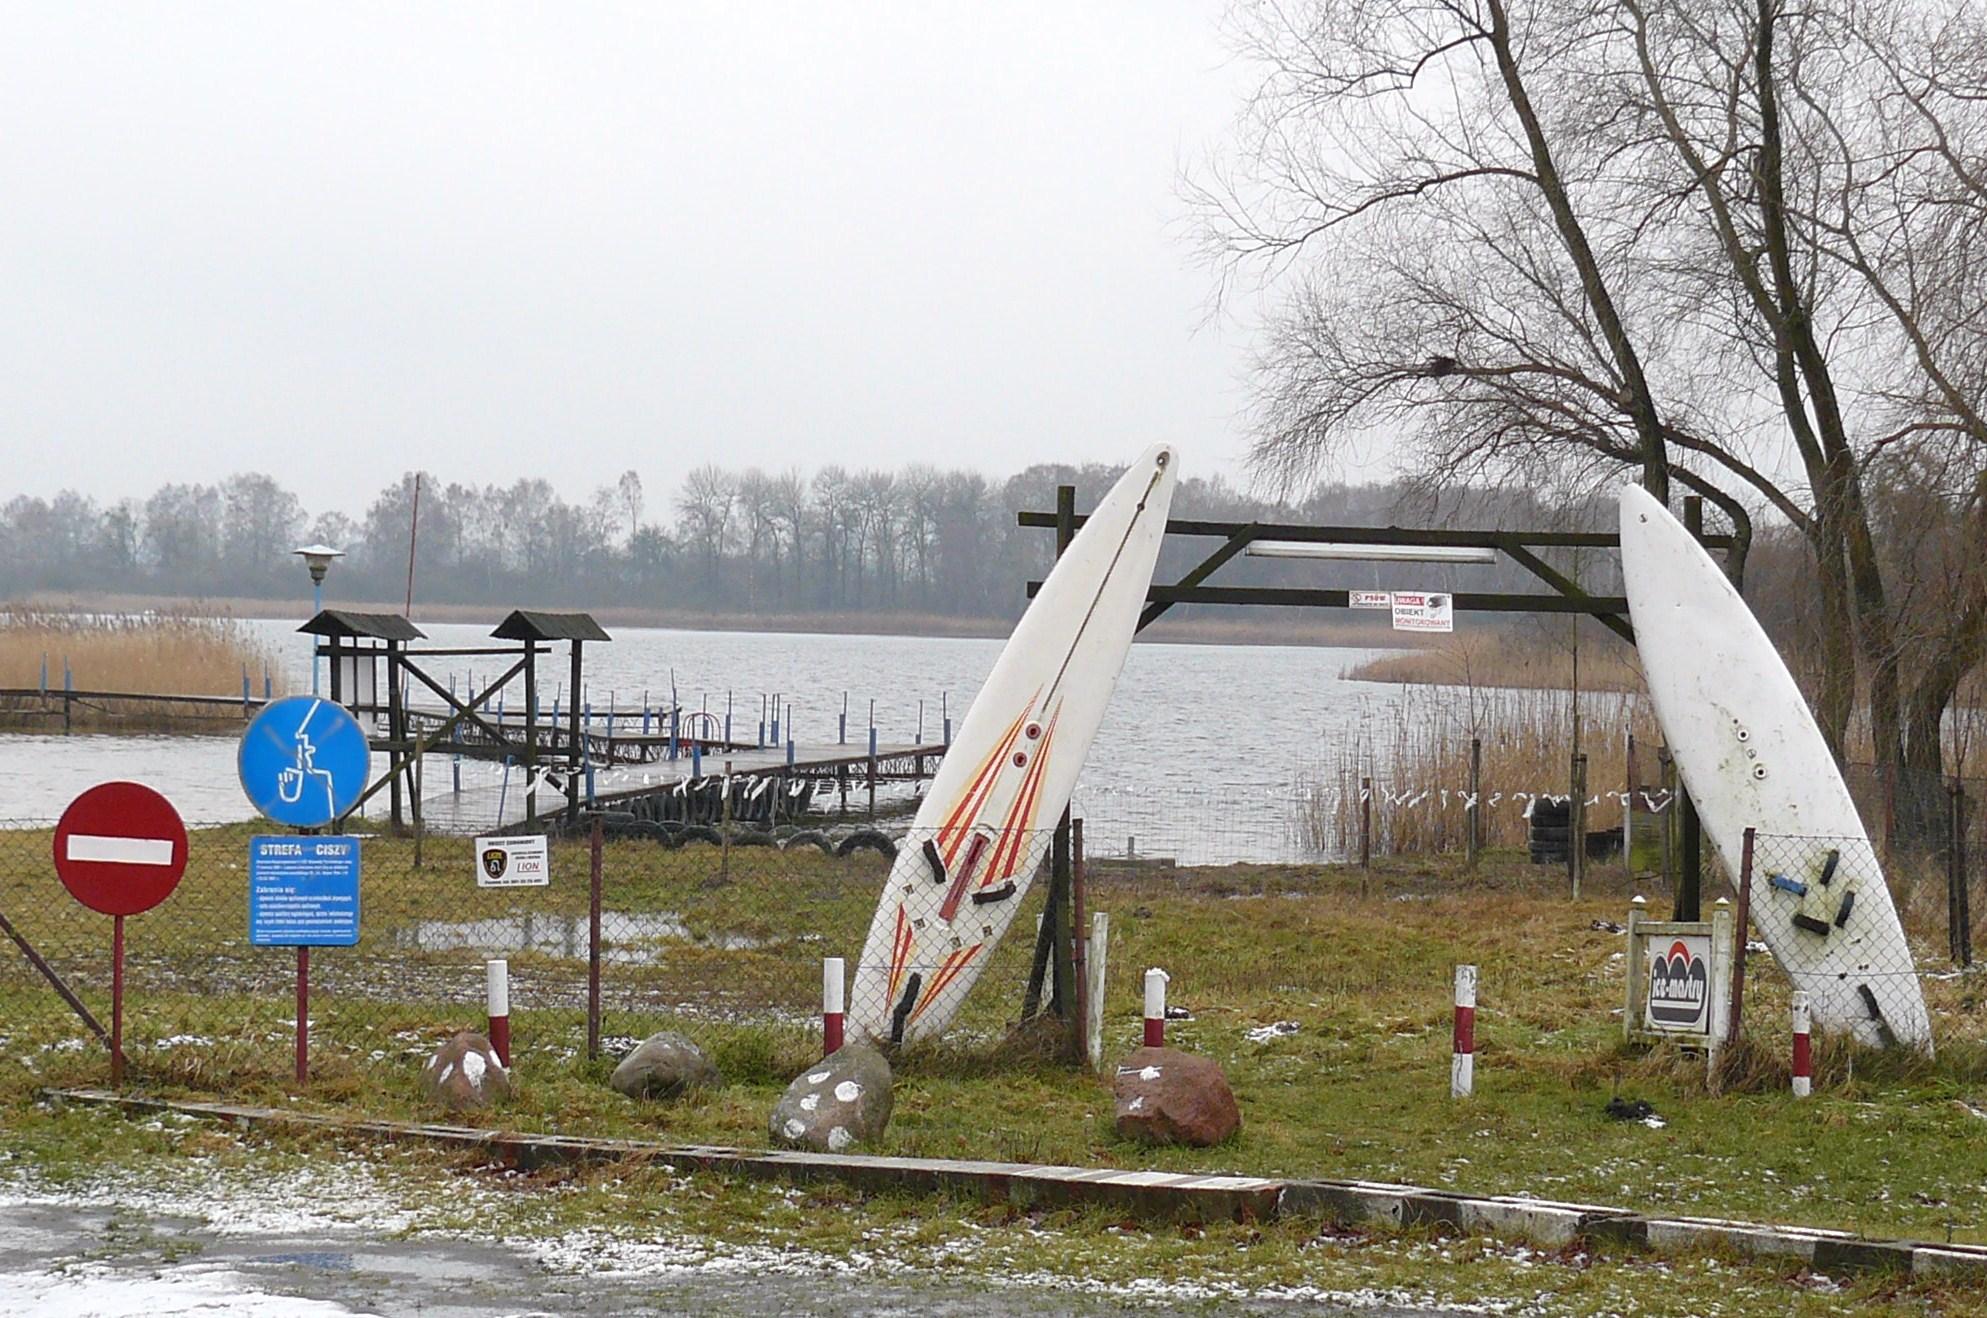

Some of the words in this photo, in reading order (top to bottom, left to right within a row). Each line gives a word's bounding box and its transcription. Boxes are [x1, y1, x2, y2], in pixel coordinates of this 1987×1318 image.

[1395, 608, 1424, 616] OBIEKT
[1395, 617, 1451, 626] MONITOROWANY
[260, 844, 302, 856] STREFA
[316, 844, 350, 856] CISZY
[517, 861, 541, 872] LION
